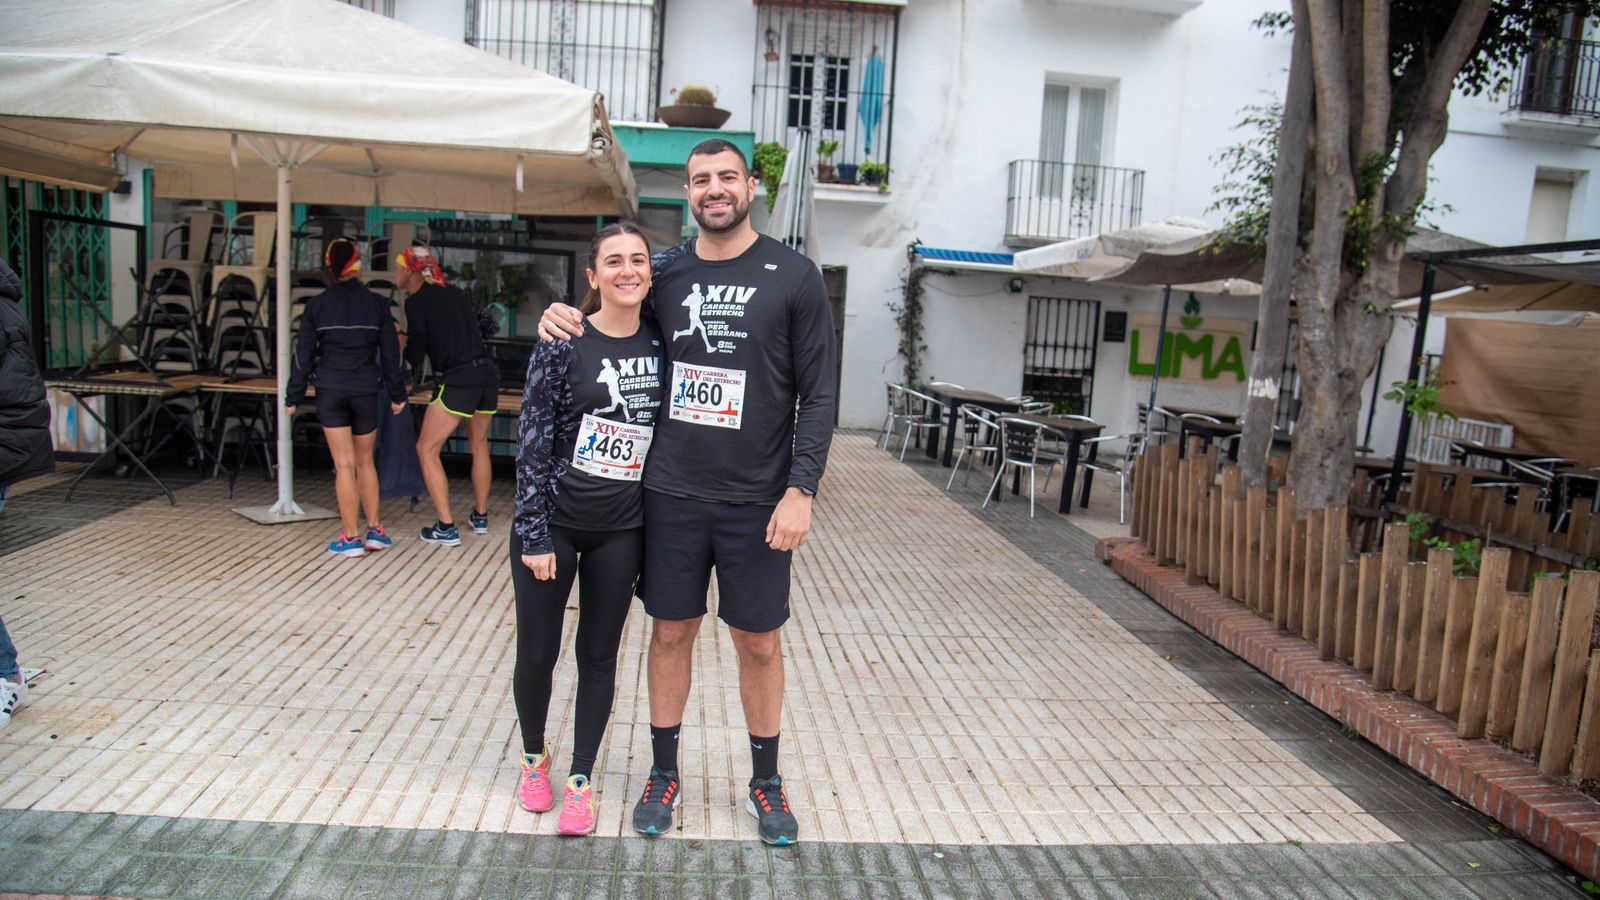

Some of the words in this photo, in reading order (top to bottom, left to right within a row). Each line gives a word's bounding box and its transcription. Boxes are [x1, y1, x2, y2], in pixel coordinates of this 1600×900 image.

[706, 285, 757, 304] XIV
[707, 330, 748, 338] SERRANO
[717, 340, 725, 349] 8
[1128, 329, 1246, 382] LIMA
[618, 357, 659, 377] XIV
[683, 368, 702, 381] XIV
[620, 381, 660, 391] ESTRECHO
[686, 381, 723, 406] 460
[594, 421, 621, 436] XIV
[596, 436, 634, 461] 463
